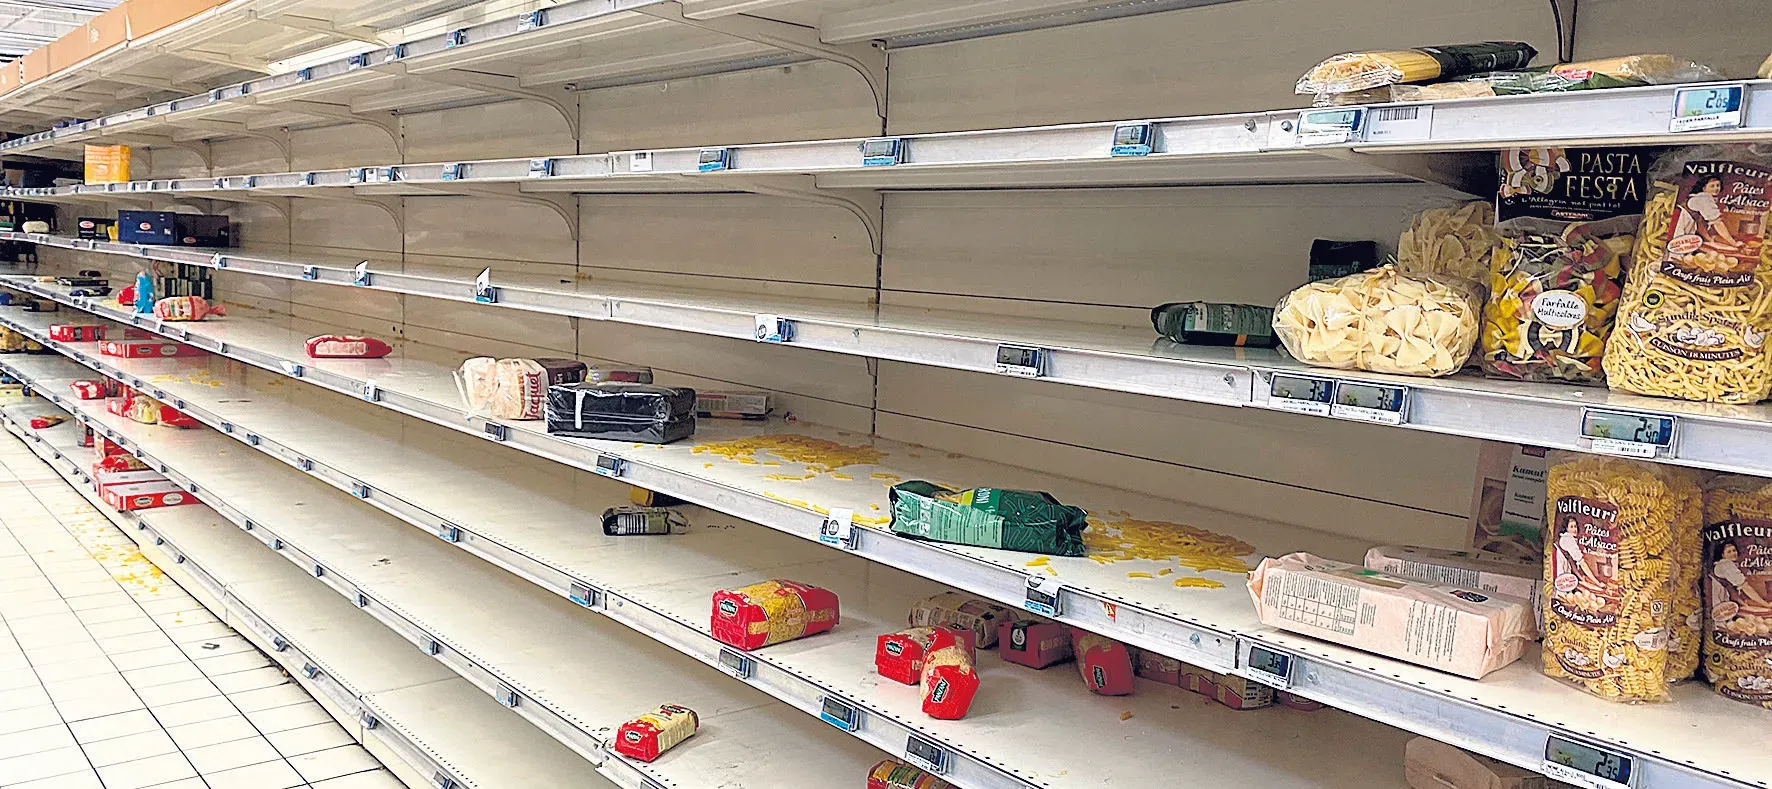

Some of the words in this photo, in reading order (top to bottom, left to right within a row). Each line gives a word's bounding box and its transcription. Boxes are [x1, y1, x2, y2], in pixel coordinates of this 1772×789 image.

[1580, 152, 1642, 174] PASTA
[1566, 175, 1639, 201] FESTA
[1732, 181, 1764, 195] Pâtes
[1720, 194, 1770, 208] d'Alsace
[1664, 263, 1675, 271] 7
[1691, 272, 1711, 283] frais
[1713, 273, 1734, 284] Plein
[1736, 273, 1752, 284] Air
[1541, 297, 1580, 309] Farfalle
[1651, 338, 1687, 358] CUISSON
[1699, 350, 1741, 360] MINUTES
[525, 371, 545, 420] Jaquet
[1557, 498, 1618, 524] Valfleuri
[1584, 523, 1610, 538] Pâtes
[1578, 537, 1617, 551] d'Alsace
[1553, 600, 1560, 608] 7
